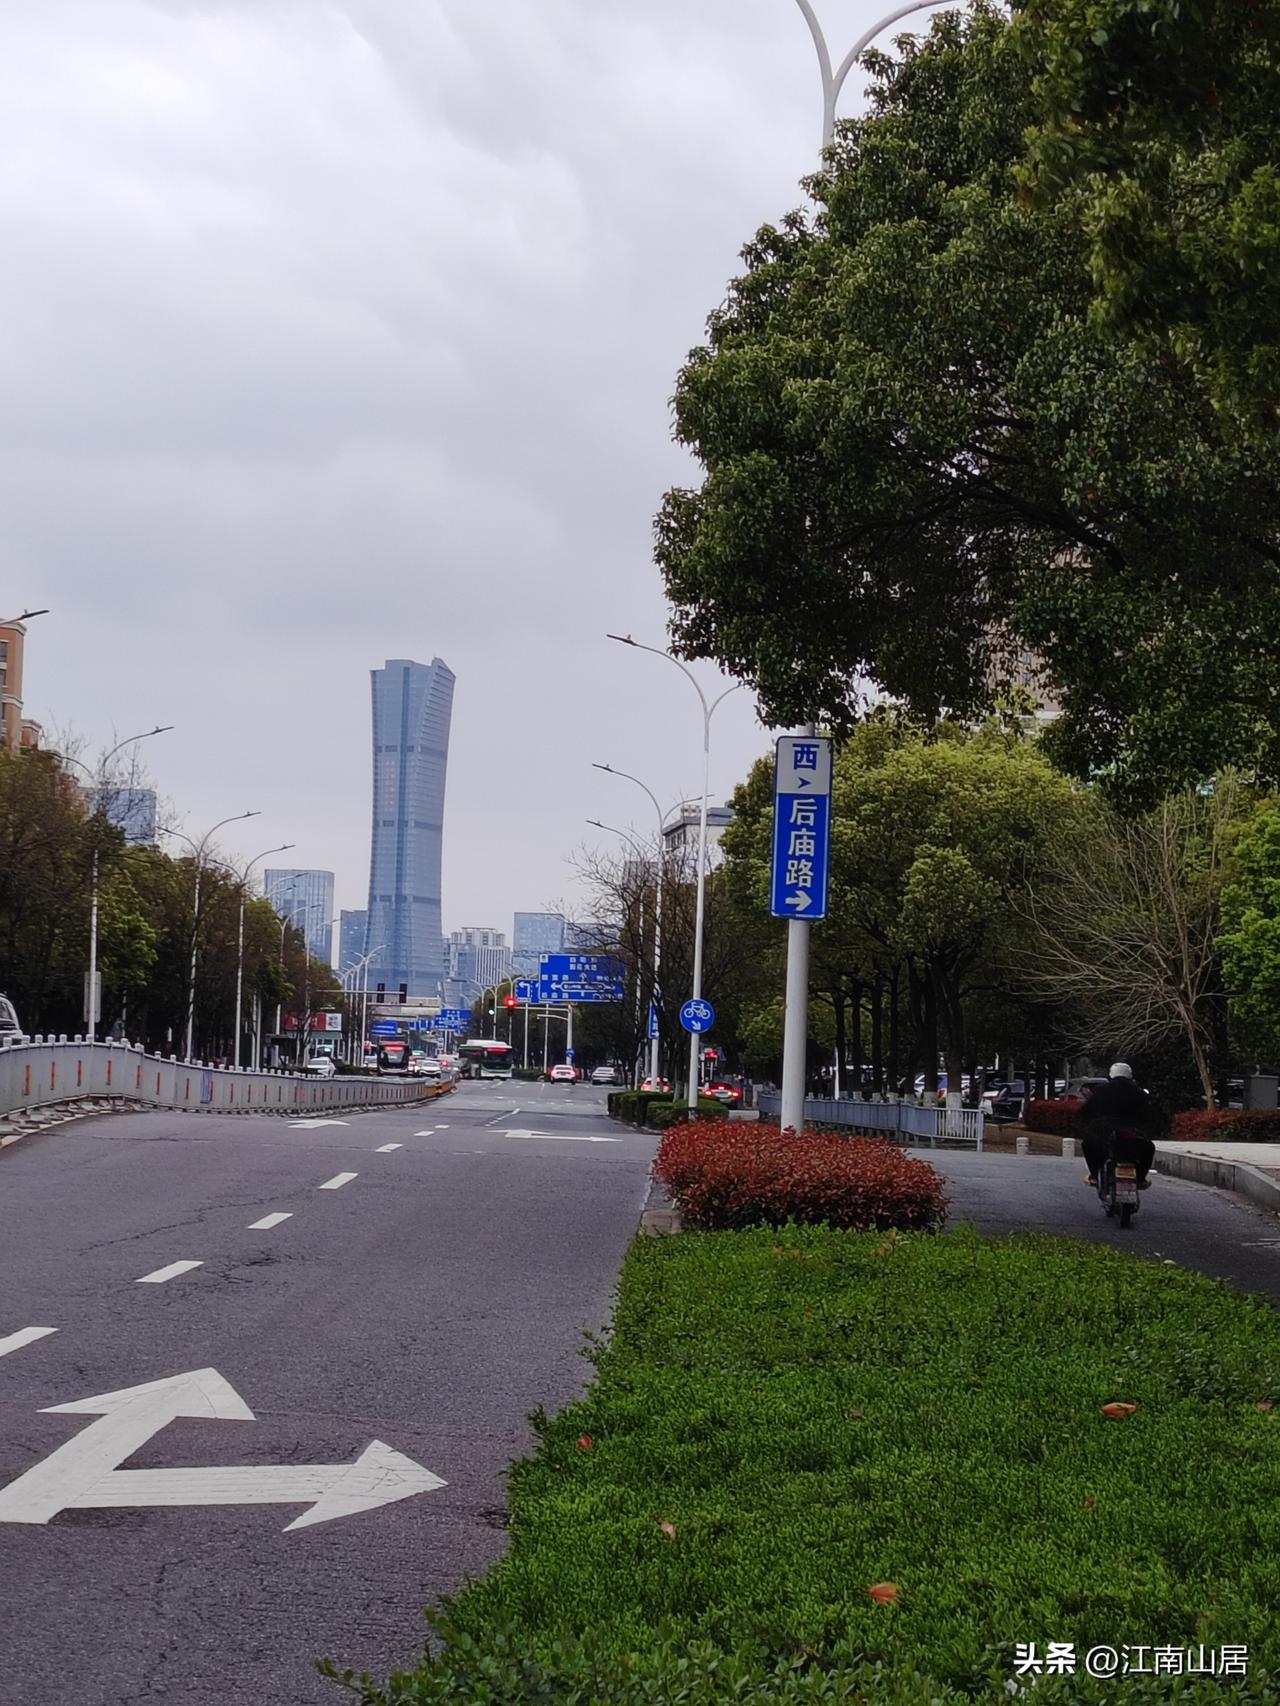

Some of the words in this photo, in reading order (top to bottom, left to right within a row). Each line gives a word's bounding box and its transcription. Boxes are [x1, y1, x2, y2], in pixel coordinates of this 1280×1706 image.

[792, 743, 820, 770] 西
[785, 799, 818, 888] 后庙路
